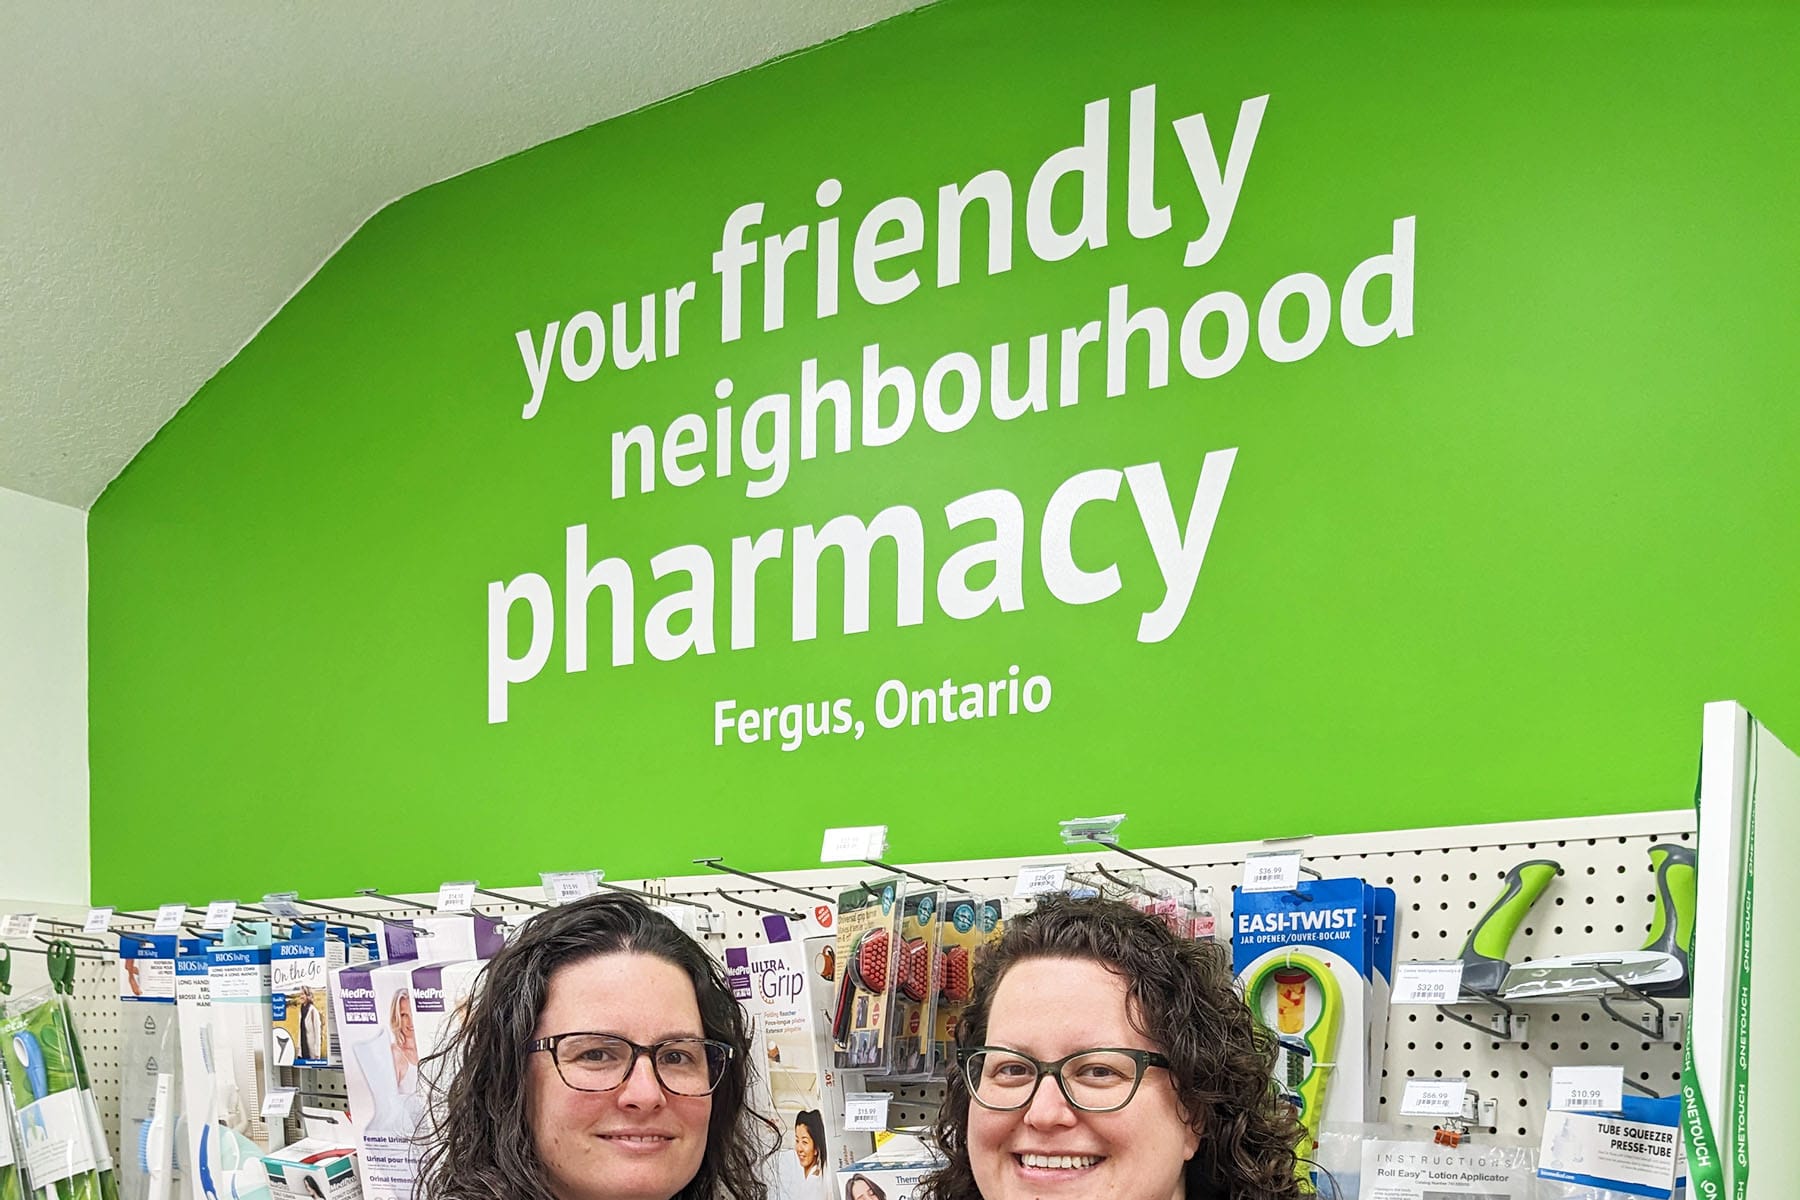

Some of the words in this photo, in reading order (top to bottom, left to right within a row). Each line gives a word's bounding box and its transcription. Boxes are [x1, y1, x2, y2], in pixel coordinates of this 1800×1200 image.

[515, 280, 696, 419] your
[711, 83, 1270, 343] friendly
[610, 215, 1417, 500] neighbourhood
[487, 447, 1239, 724] pharmacy
[713, 698, 865, 751] Fergus,
[875, 664, 1053, 729] Ontario
[1259, 866, 1283, 875] $36.99
[1238, 908, 1357, 934] EASI-TWIST
[1240, 935, 1254, 945] JAR
[1257, 931, 1351, 944] OPENER/OUVRE-BOCAUX
[1744, 891, 1752, 973] ONETOUCH
[215, 953, 233, 962] BIOS
[281, 945, 298, 956] BIOS
[298, 946, 315, 956] living
[273, 968, 289, 984] On
[289, 961, 306, 981] the
[307, 961, 321, 980] Go
[751, 959, 785, 974] ULTRA
[340, 988, 375, 999] MedPro
[413, 987, 445, 998] MedPro
[762, 968, 804, 1004] Grip
[1417, 983, 1445, 991] $32.00
[1739, 987, 1748, 1070] ONETOUCH
[1571, 1090, 1601, 1098] $10.99
[1598, 1123, 1621, 1136] TUBE
[1623, 1127, 1673, 1144] SQUEEZER
[1684, 1085, 1712, 1168] ONETOUCH
[1737, 1084, 1748, 1167] ONETOUCH
[1610, 1139, 1672, 1158] PRESSE-TUBE
[1377, 1154, 1512, 1168] INSTRUCTIONS
[1378, 1168, 1396, 1177] Roll
[1428, 1171, 1459, 1180] Lotion
[1460, 1173, 1510, 1182] Applicator
